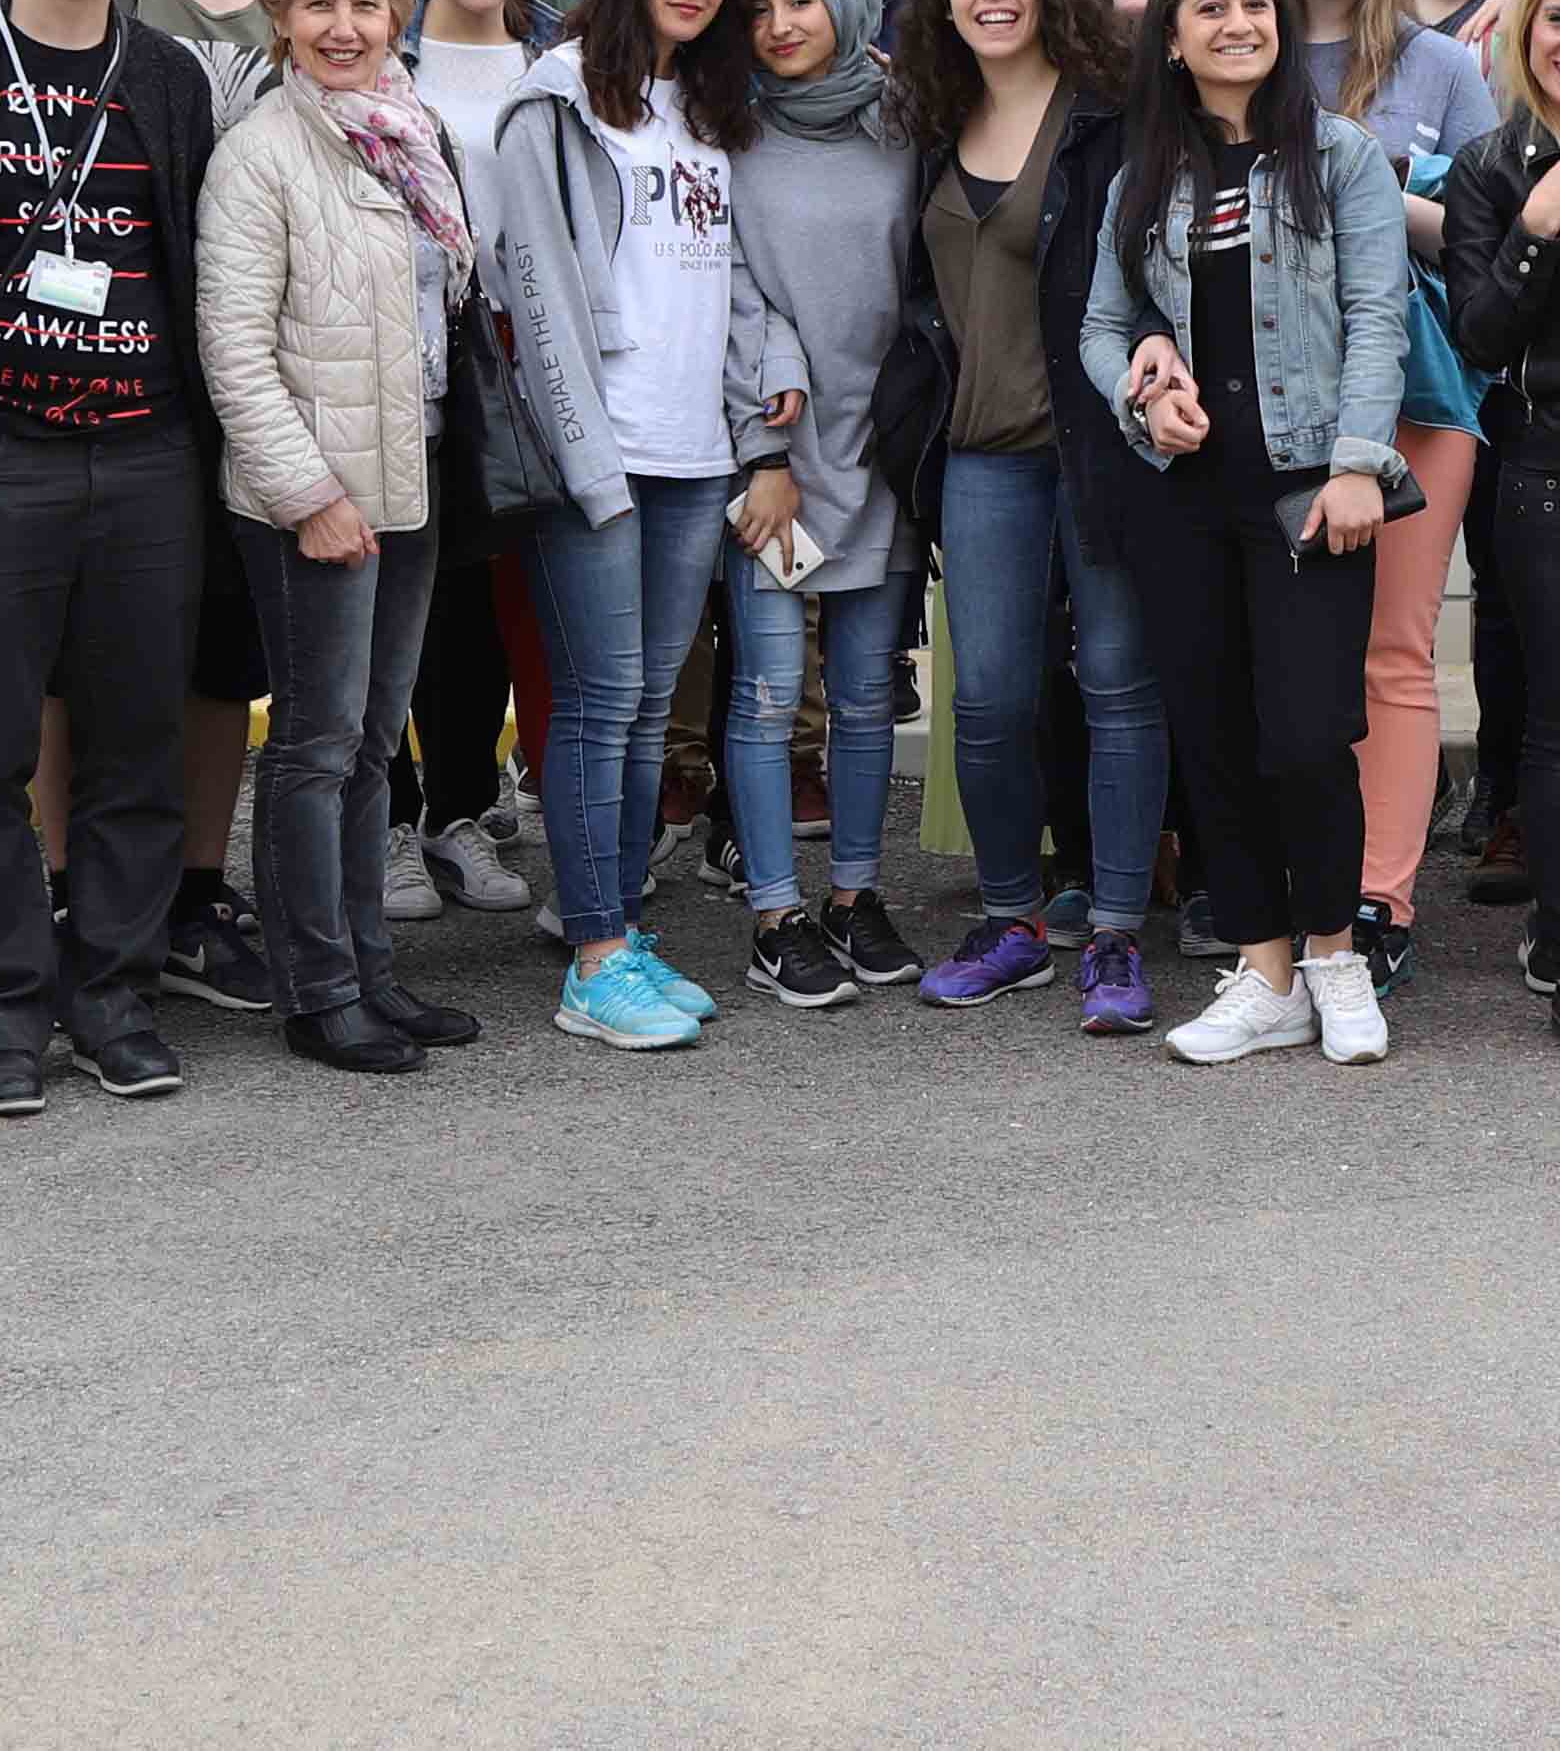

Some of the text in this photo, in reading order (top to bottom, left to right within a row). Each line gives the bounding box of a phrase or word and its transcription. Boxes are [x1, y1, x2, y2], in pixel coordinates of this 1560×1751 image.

[514, 241, 585, 444] EXHALE THE PAST
